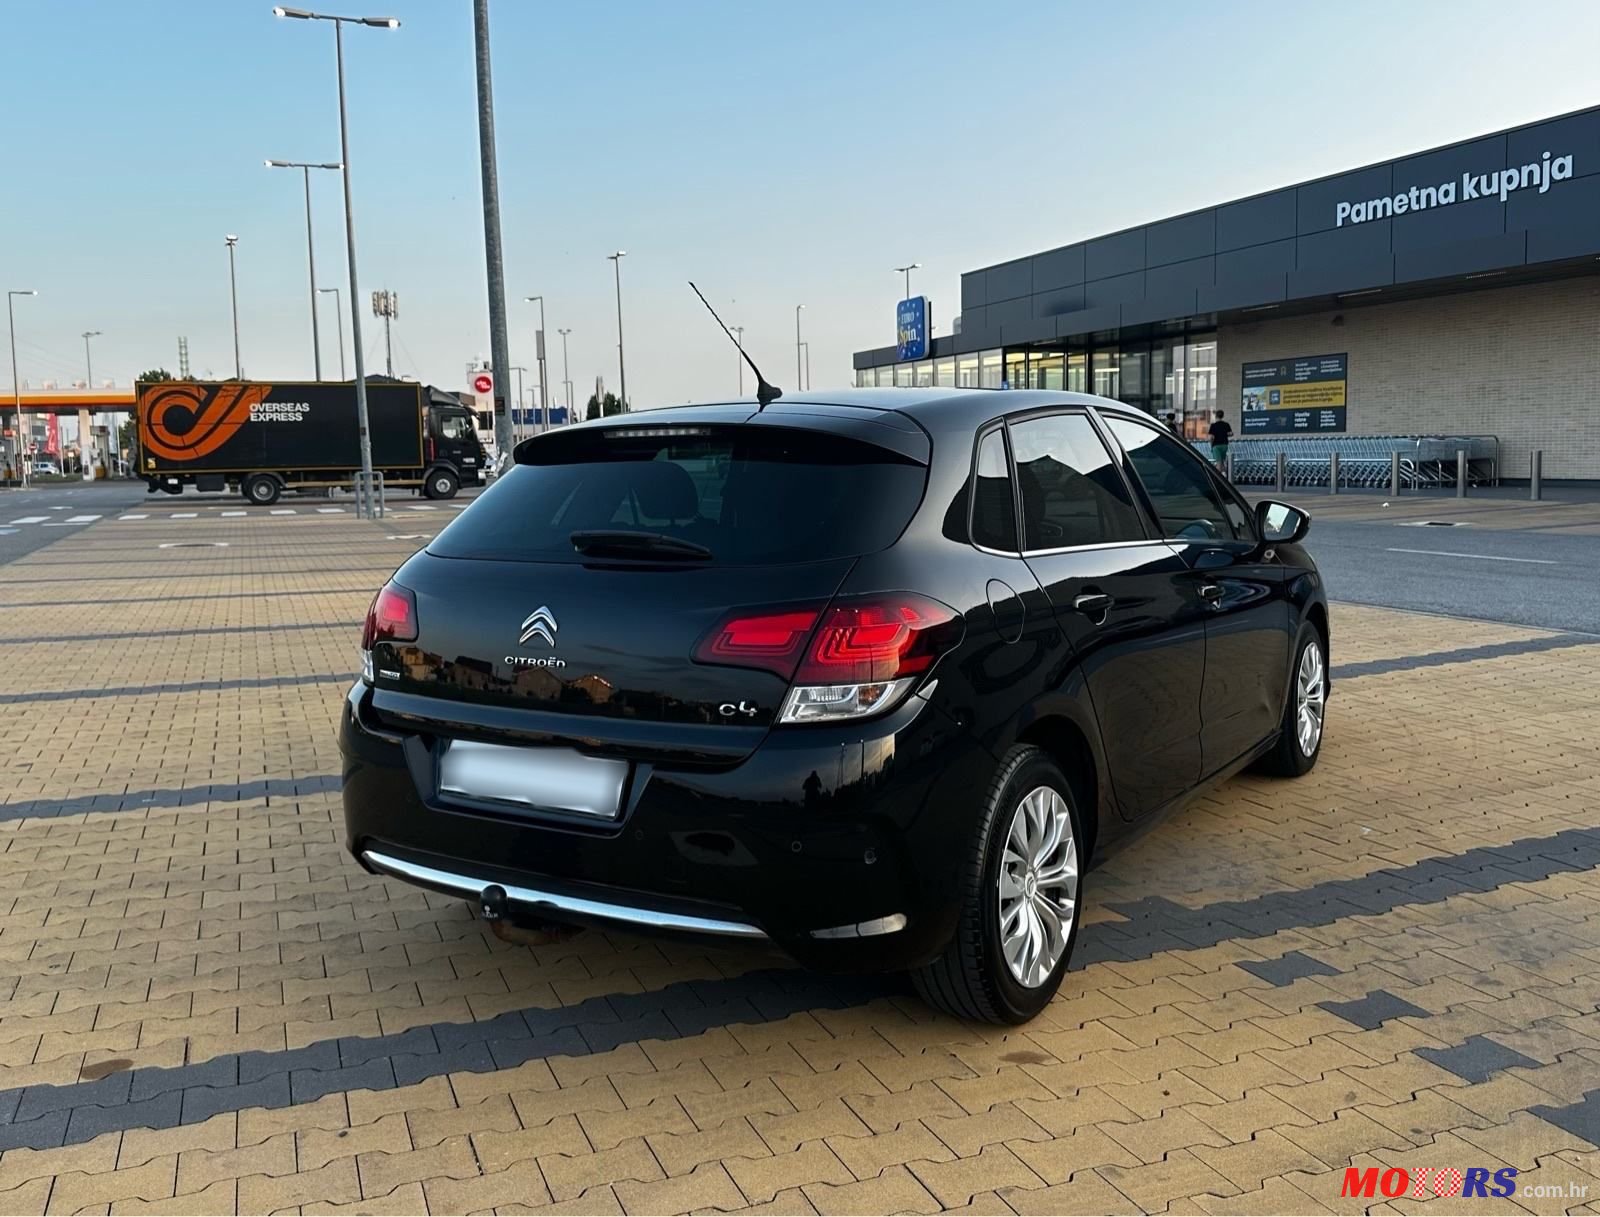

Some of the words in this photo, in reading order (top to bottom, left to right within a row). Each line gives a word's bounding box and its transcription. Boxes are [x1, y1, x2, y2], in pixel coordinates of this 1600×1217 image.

[1336, 181, 1456, 227] Pametna
[1463, 151, 1573, 202] kupnja
[249, 403, 310, 412] OVERSEAS
[250, 412, 303, 422] EXPRESS
[719, 700, 758, 717] C4
